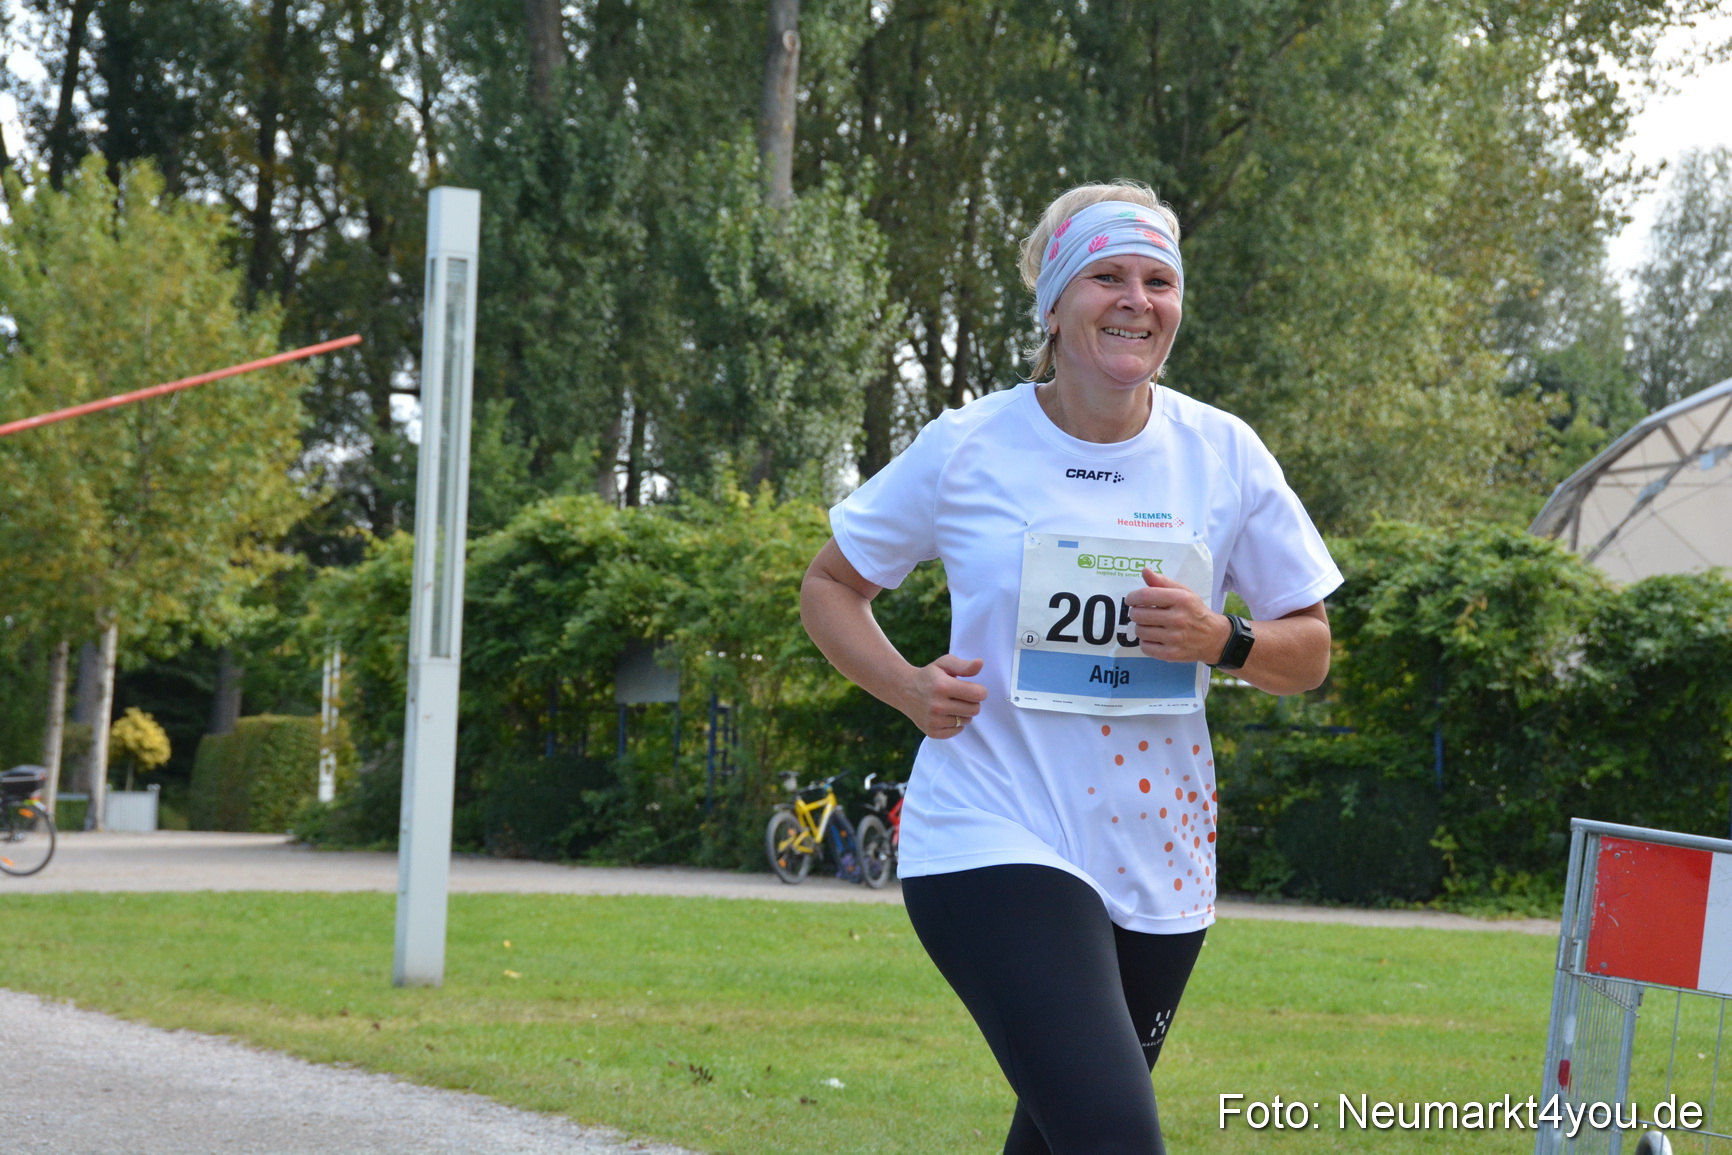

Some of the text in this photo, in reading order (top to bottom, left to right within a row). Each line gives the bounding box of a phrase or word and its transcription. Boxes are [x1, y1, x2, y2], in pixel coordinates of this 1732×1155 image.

[1065, 468, 1112, 481] CRAFT
[1117, 518, 1173, 528] Healthineers
[1098, 555, 1163, 574] BOCK
[1026, 634, 1034, 644] D
[1089, 664, 1130, 688] Anja
